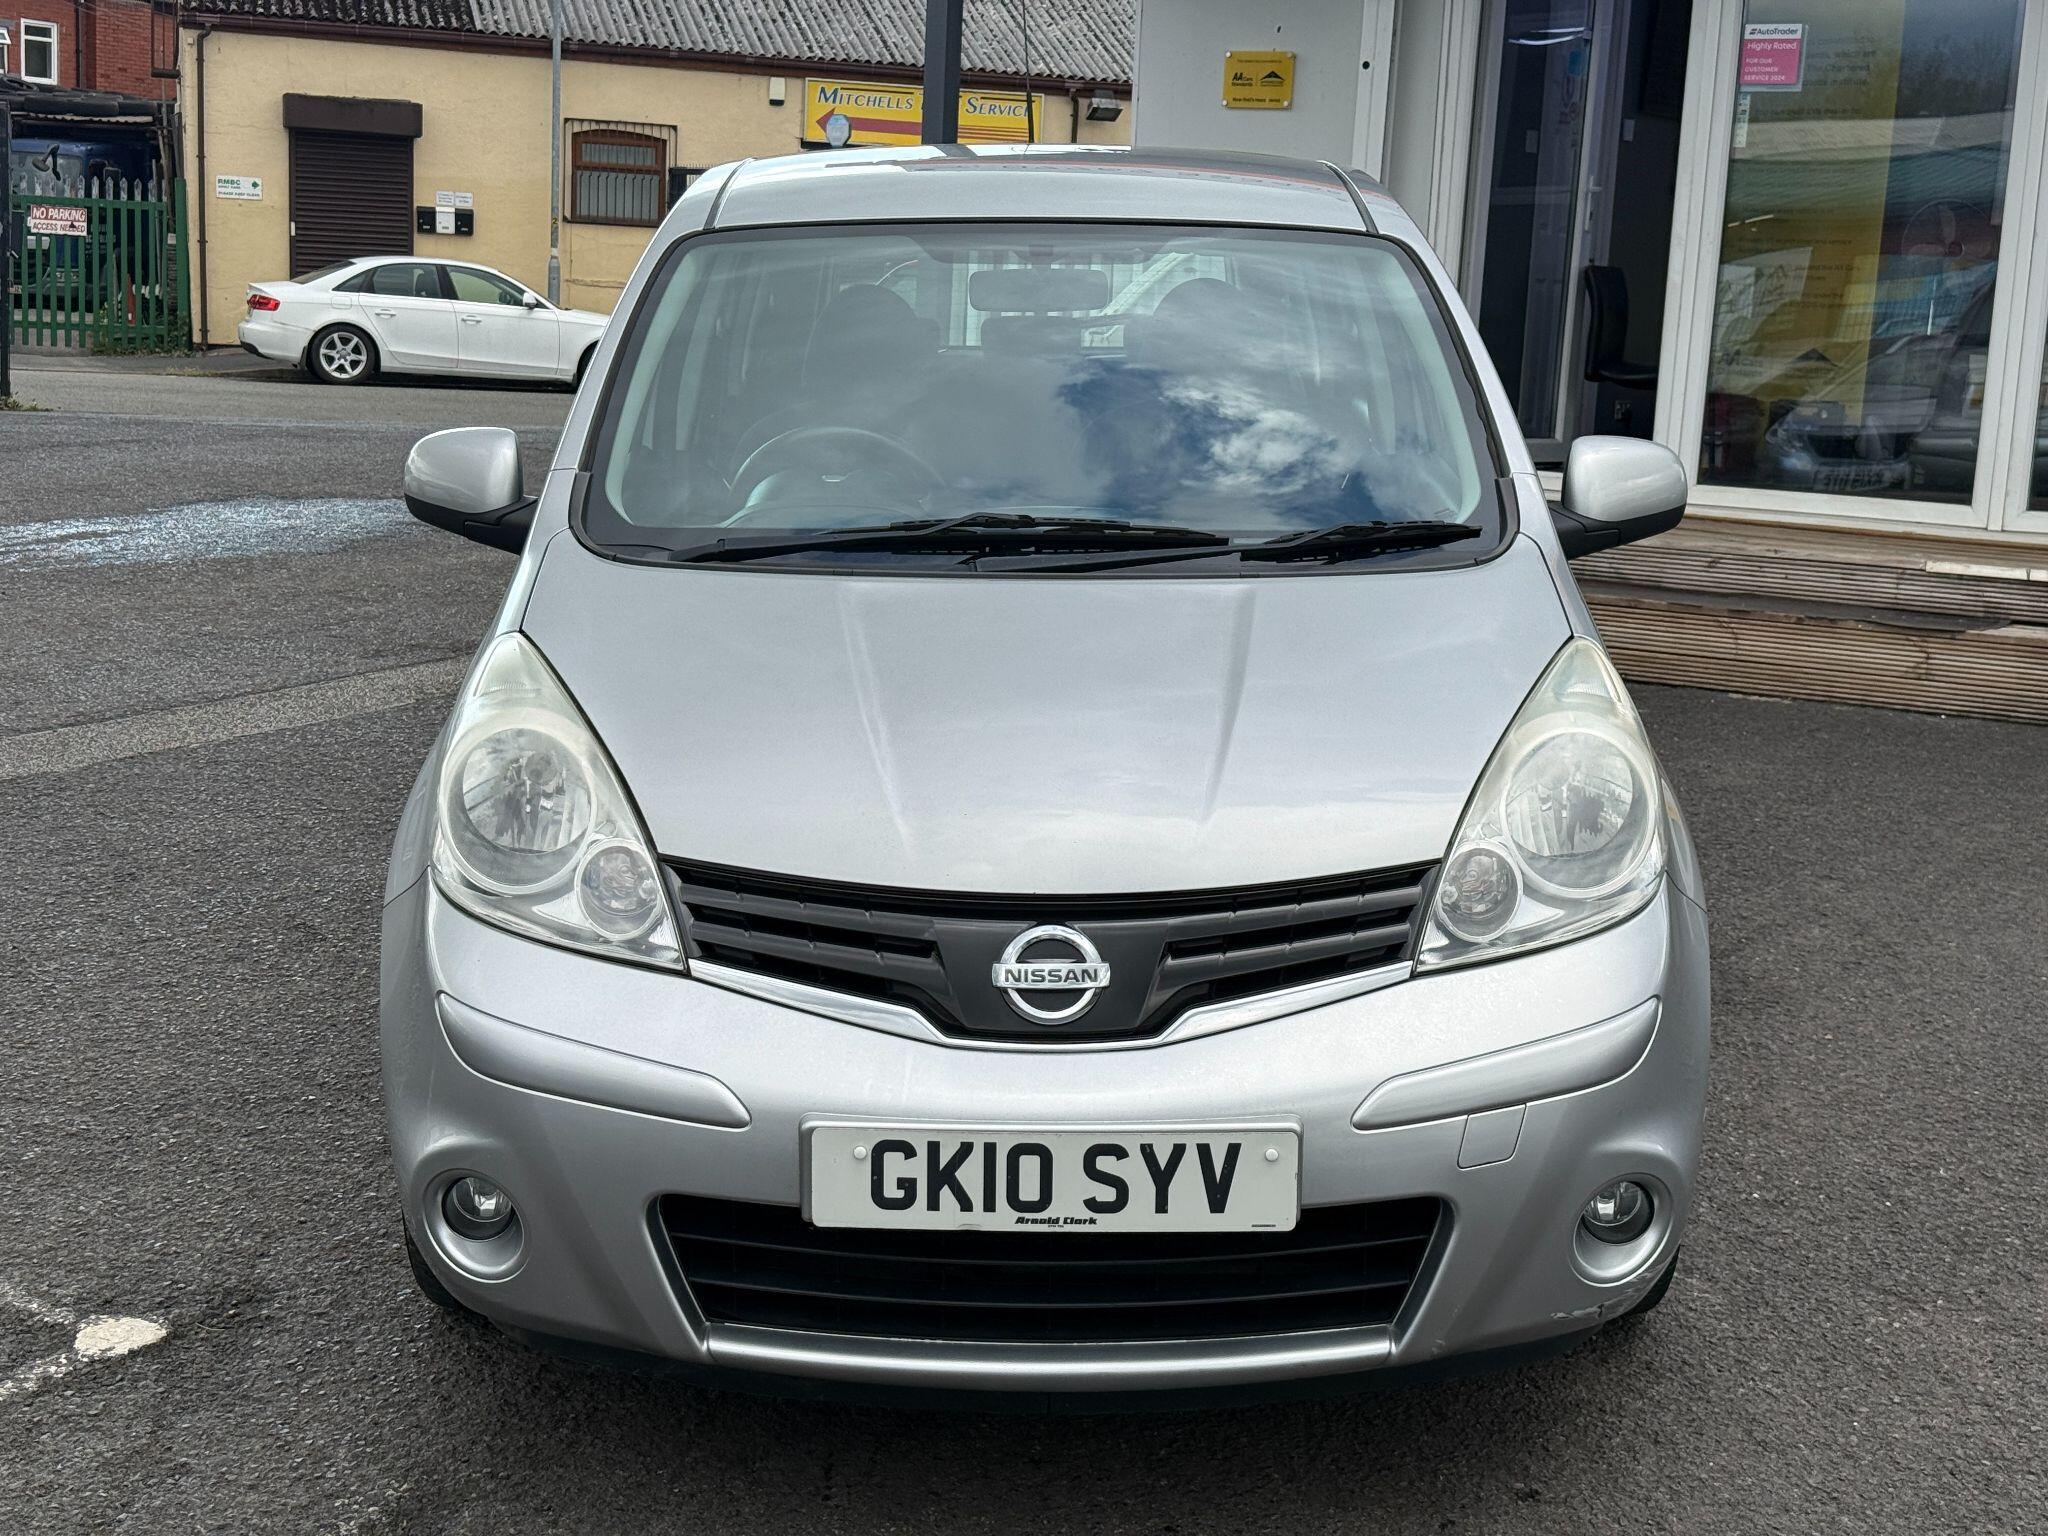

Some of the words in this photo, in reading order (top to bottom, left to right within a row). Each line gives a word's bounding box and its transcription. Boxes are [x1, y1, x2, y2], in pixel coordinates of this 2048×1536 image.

[1756, 28, 1799, 36] AutoTrader
[1747, 42, 1773, 52] Highly
[1773, 42, 1797, 50] Rated
[1232, 72, 1243, 82] AA
[818, 86, 914, 110] MITCHELLS
[32, 206, 47, 219] NO
[48, 207, 86, 221] PARKING
[33, 221, 58, 231] ACCESS
[1004, 968, 1098, 983] NISSAN
[870, 1139, 1054, 1214] GK10
[1082, 1142, 1243, 1215] SYV
[1015, 1216, 1061, 1225] Arnold
[1063, 1217, 1098, 1225] Clark
